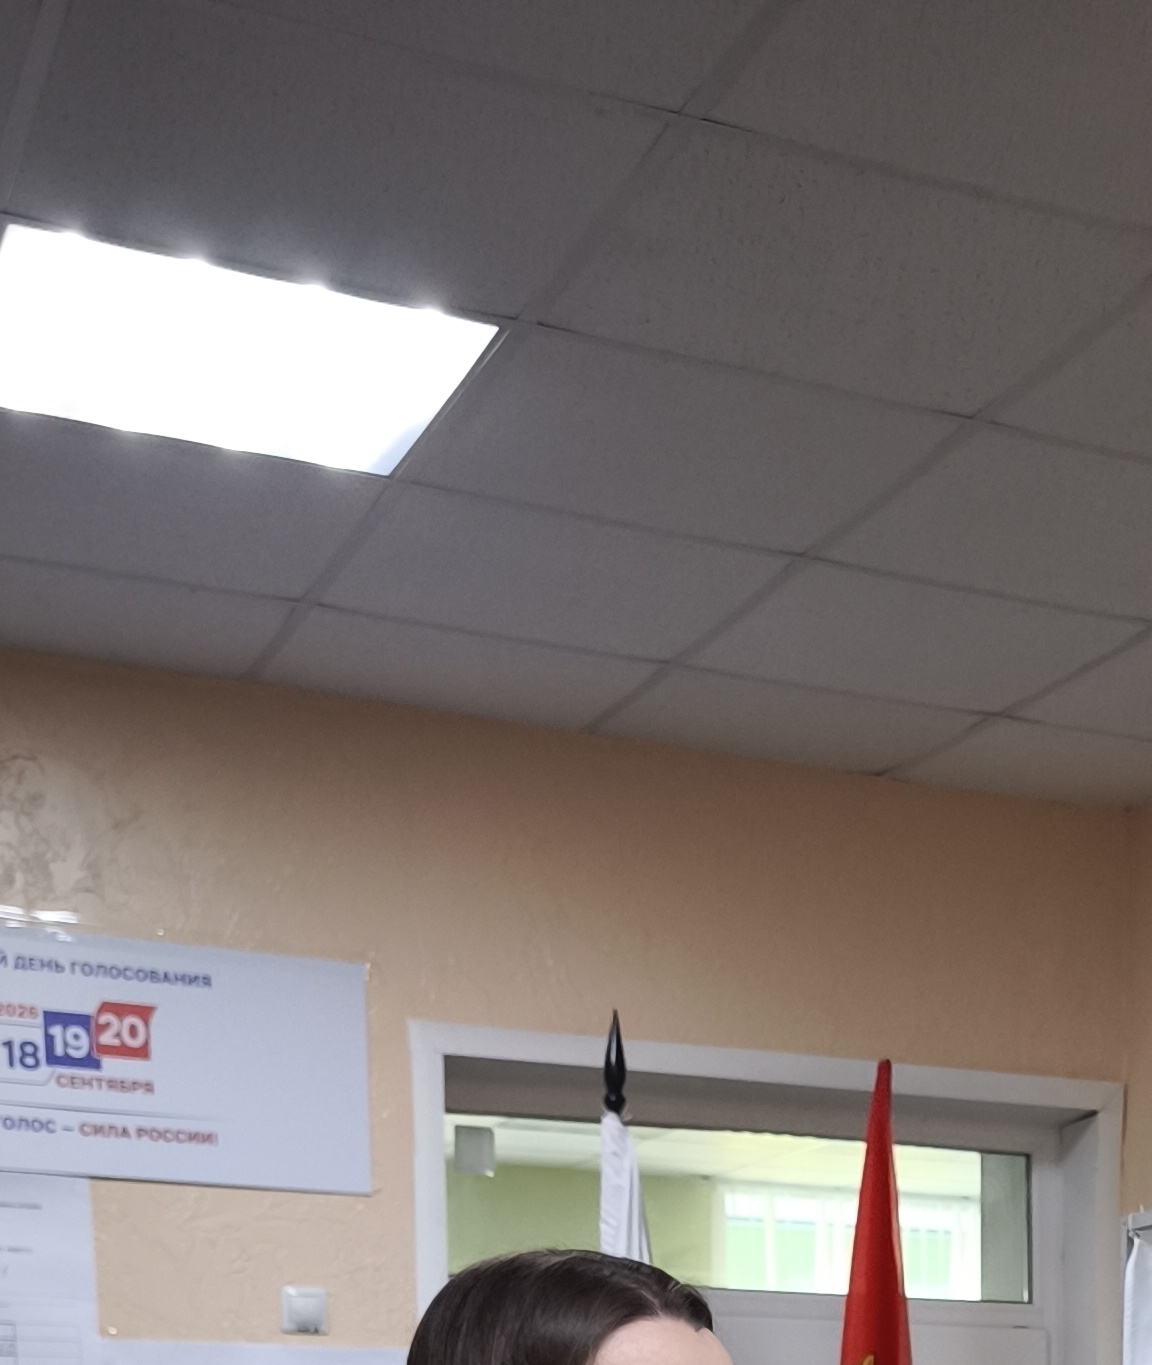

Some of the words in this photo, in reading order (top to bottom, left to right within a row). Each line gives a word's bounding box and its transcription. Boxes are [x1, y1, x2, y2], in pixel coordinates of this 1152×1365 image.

[14, 956, 65, 974] ДЕНЬ
[70, 961, 212, 988] ГОЛОСОВАНИЯ
[2, 1039, 40, 1070] 18
[48, 1024, 90, 1059] 19
[97, 1012, 147, 1048] 20
[56, 1074, 155, 1094] СЕНТЯБРЯ
[0, 1115, 56, 1133] ОЛОС
[79, 1122, 132, 1139] СИЛА
